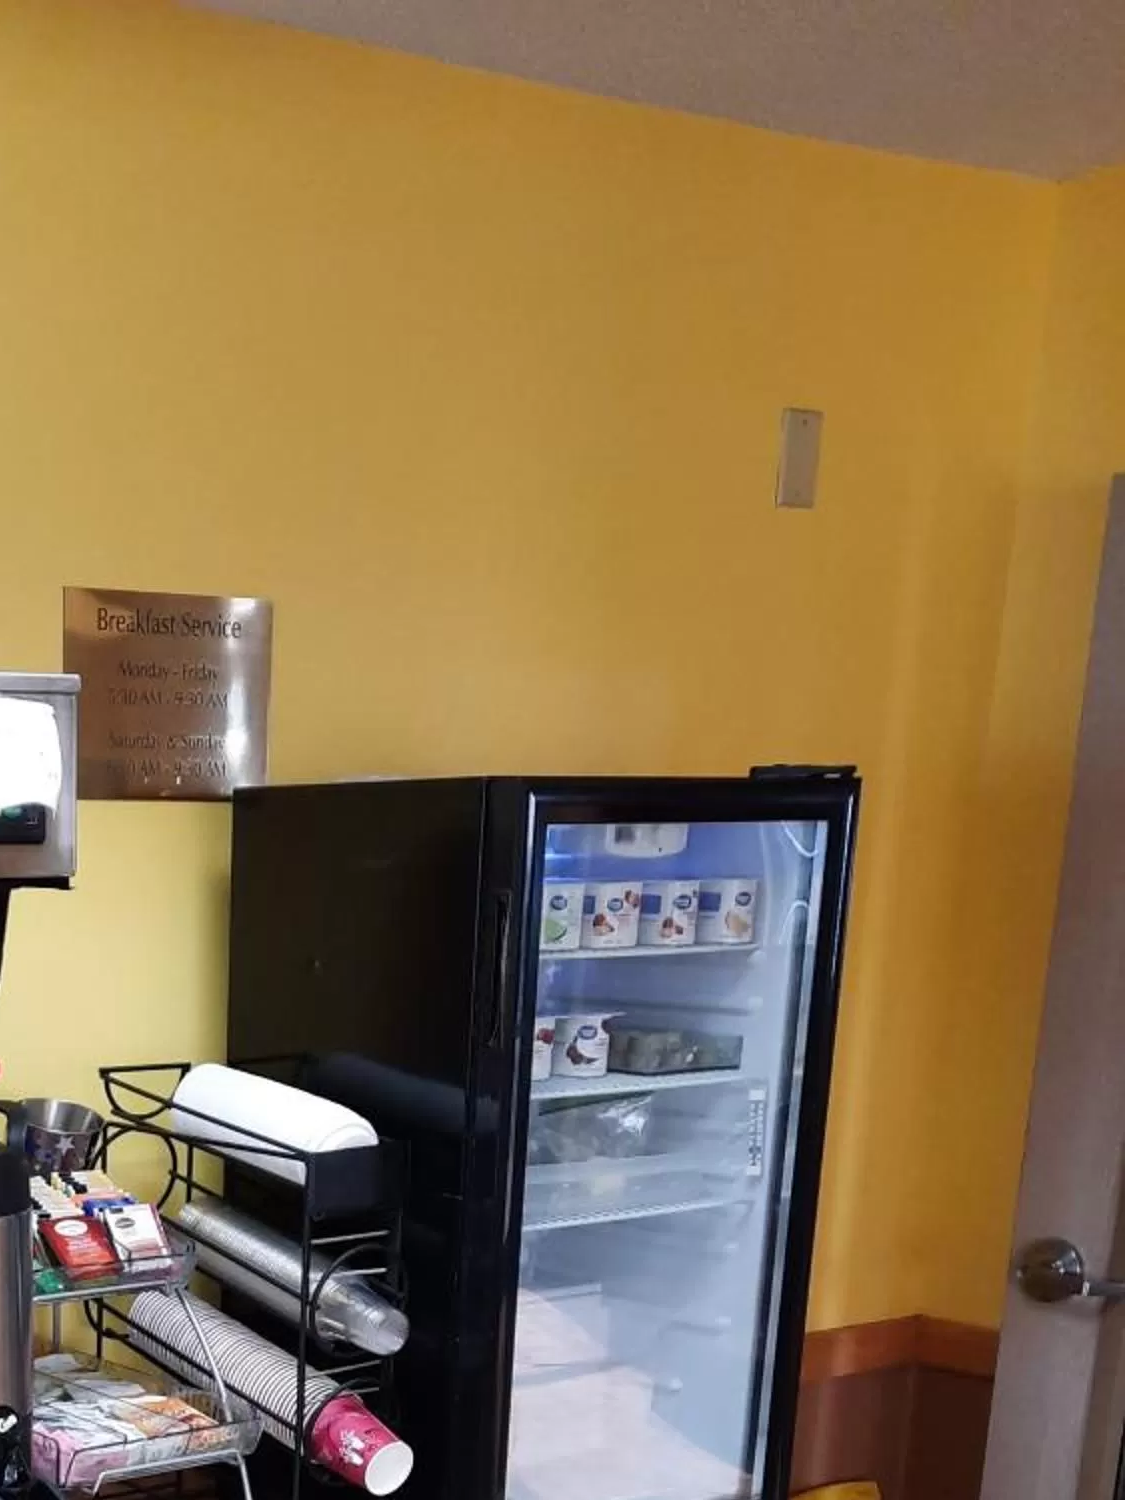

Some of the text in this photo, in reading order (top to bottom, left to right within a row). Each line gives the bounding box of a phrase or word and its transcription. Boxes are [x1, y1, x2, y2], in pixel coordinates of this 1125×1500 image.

[97, 606, 242, 639] Breakfast Service
[117, 660, 168, 680] Monday
[182, 660, 219, 688] Friday
